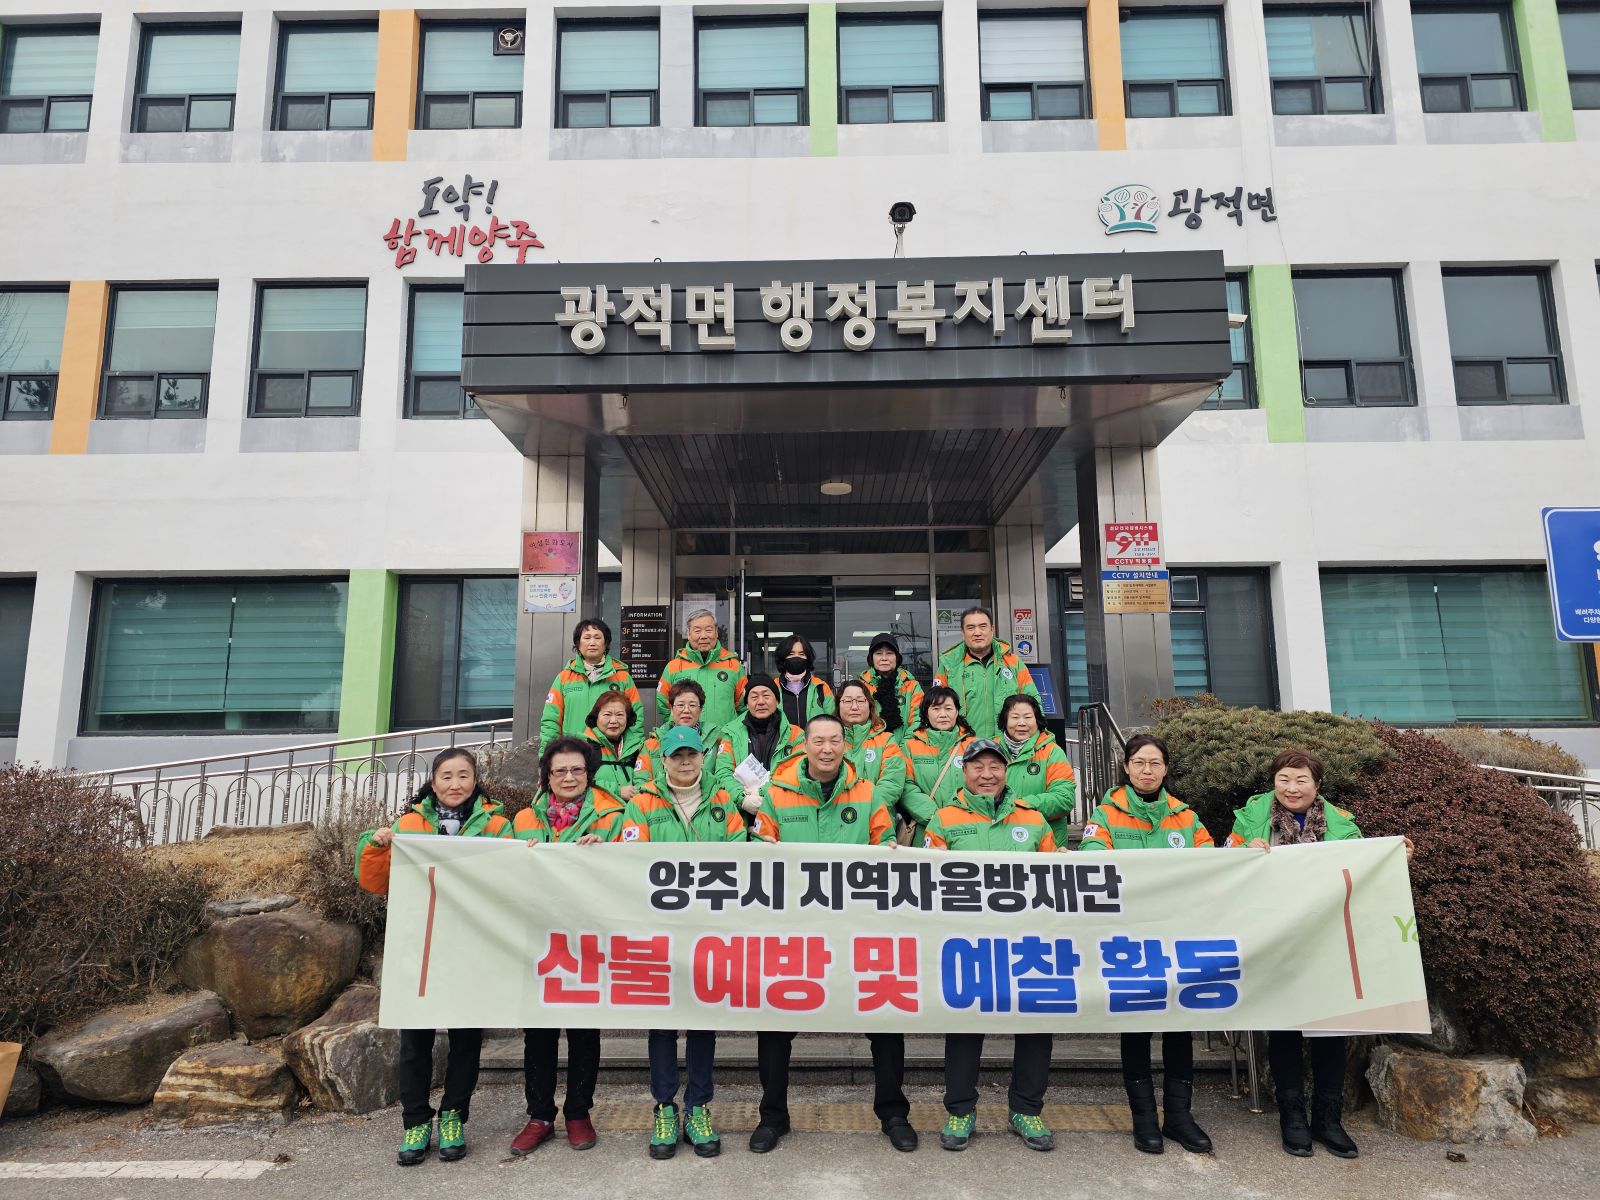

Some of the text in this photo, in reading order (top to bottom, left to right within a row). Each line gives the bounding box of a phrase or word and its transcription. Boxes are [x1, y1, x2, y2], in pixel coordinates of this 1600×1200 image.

[418, 174, 498, 221] 도약!
[1168, 186, 1277, 230] 광적면
[554, 273, 1136, 354] 광적면 행정복지센터
[1114, 531, 1150, 556] 911
[1132, 571, 1159, 579] 설치안내
[621, 646, 630, 654] 2F
[622, 627, 631, 635] 3F
[649, 860, 1123, 914] 양주시 지역자율방재단
[537, 932, 1241, 1014] 산불 예방 및 예찰 활동
